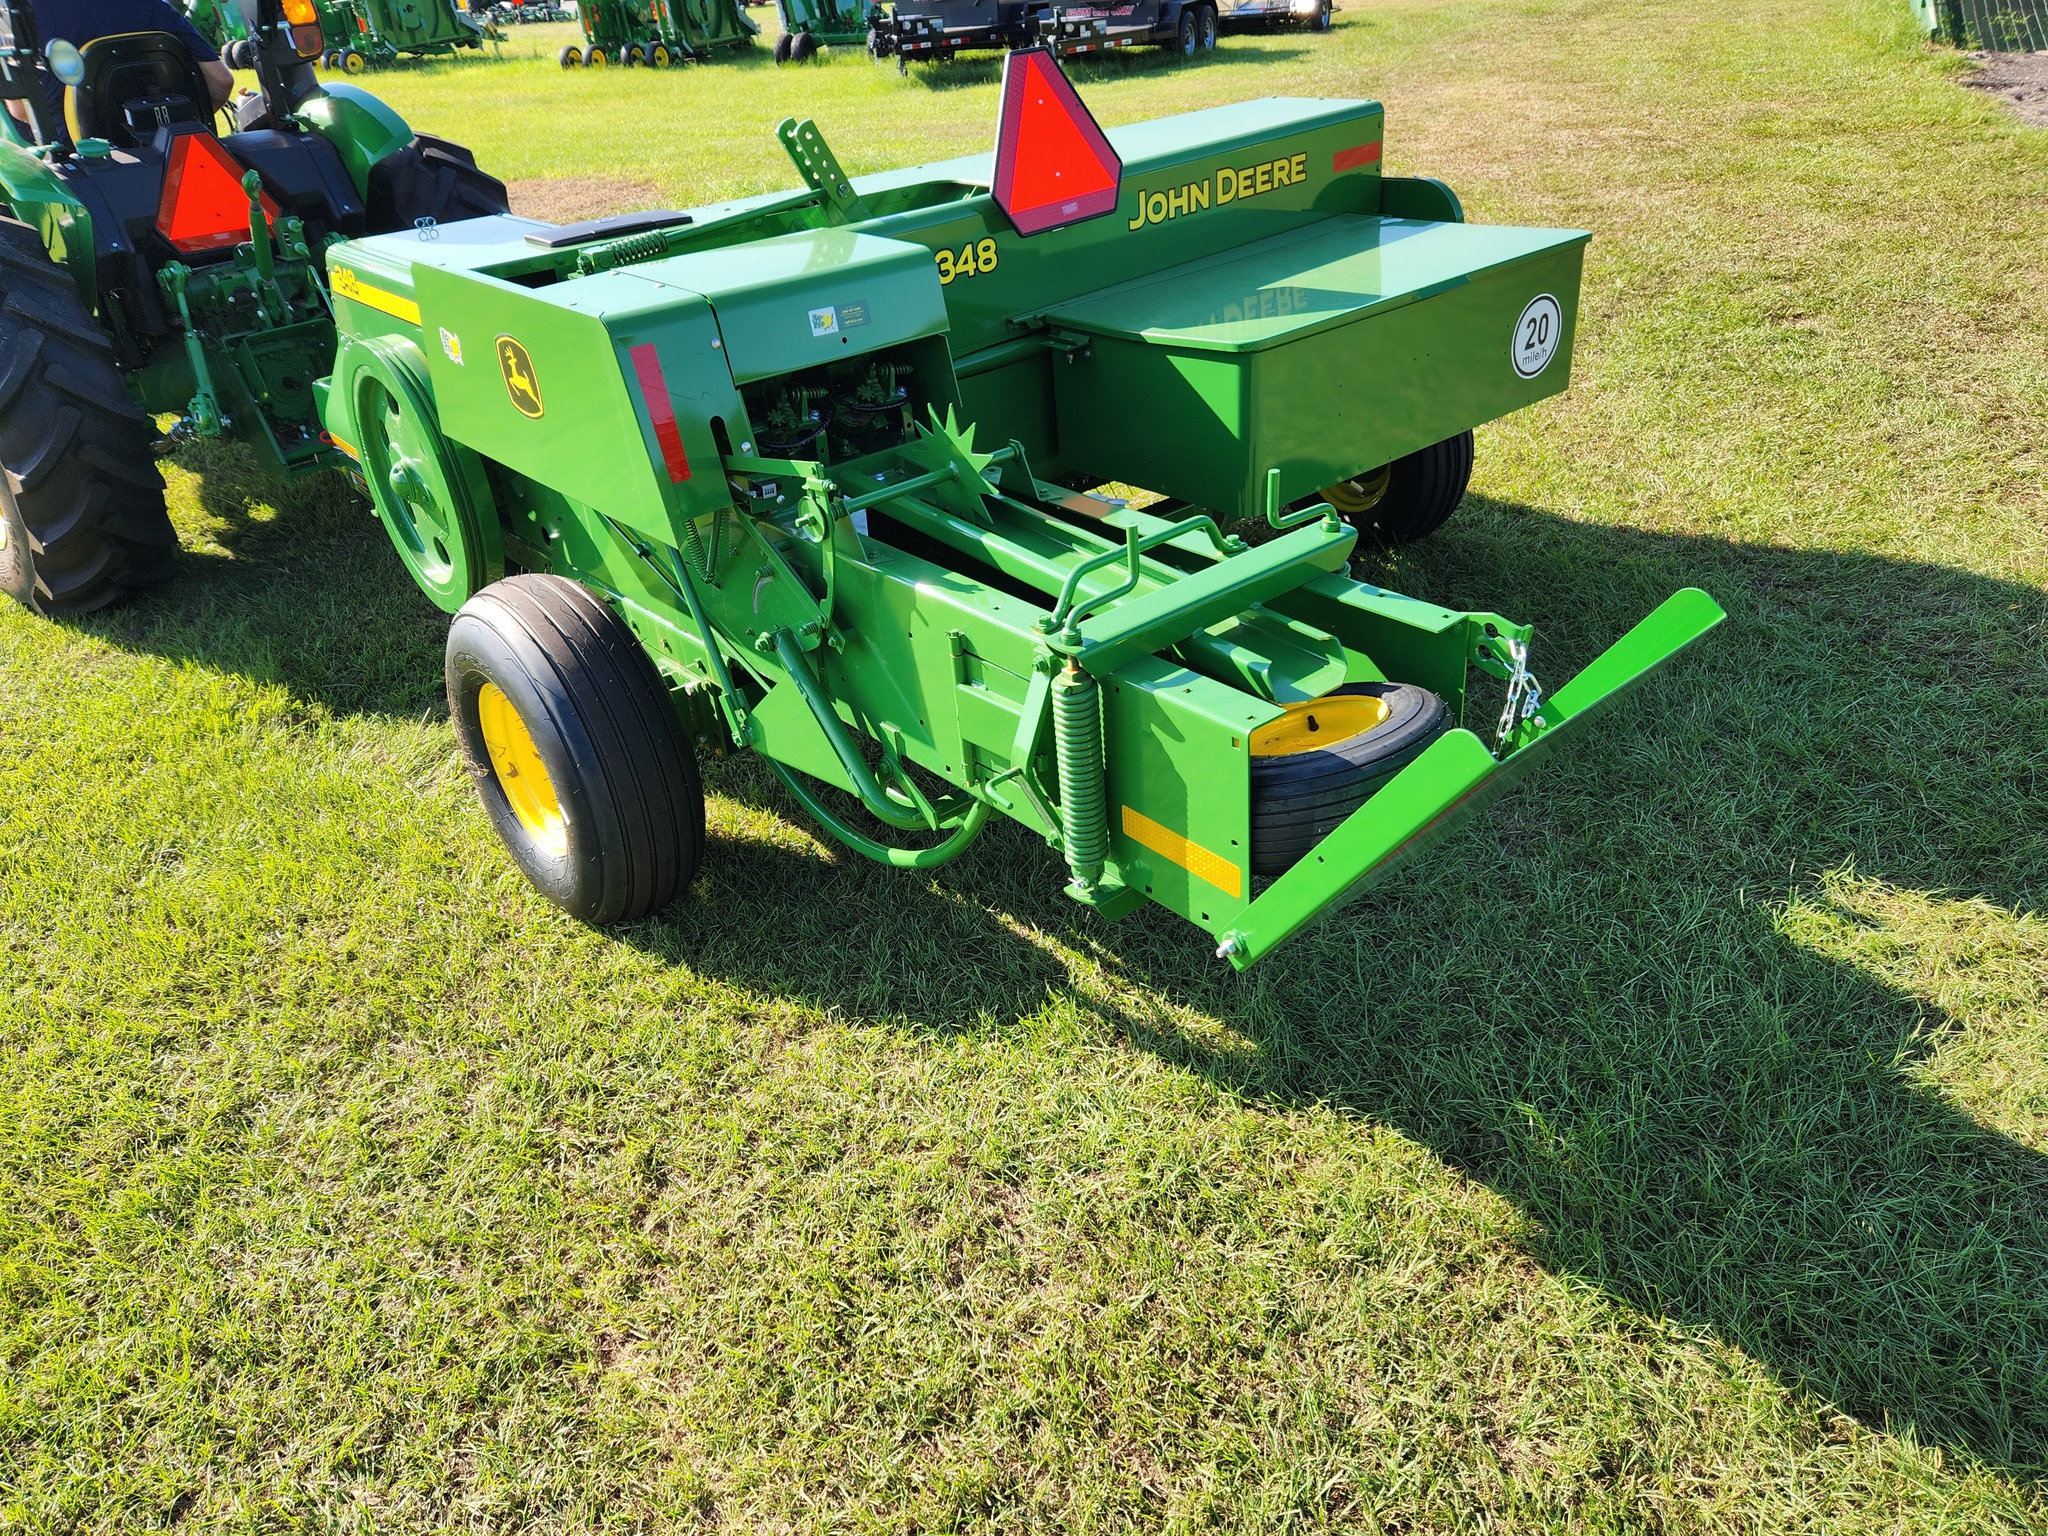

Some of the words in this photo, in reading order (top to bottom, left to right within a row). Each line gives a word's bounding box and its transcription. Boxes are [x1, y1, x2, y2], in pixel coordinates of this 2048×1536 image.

[1066, 8, 1091, 16] FARM
[1129, 178, 1210, 231] JOHN
[1216, 152, 1307, 206] DEERE
[934, 237, 998, 285] 348
[334, 264, 359, 295] 348
[1524, 313, 1549, 351] 20
[1522, 346, 1547, 366] mile/h
